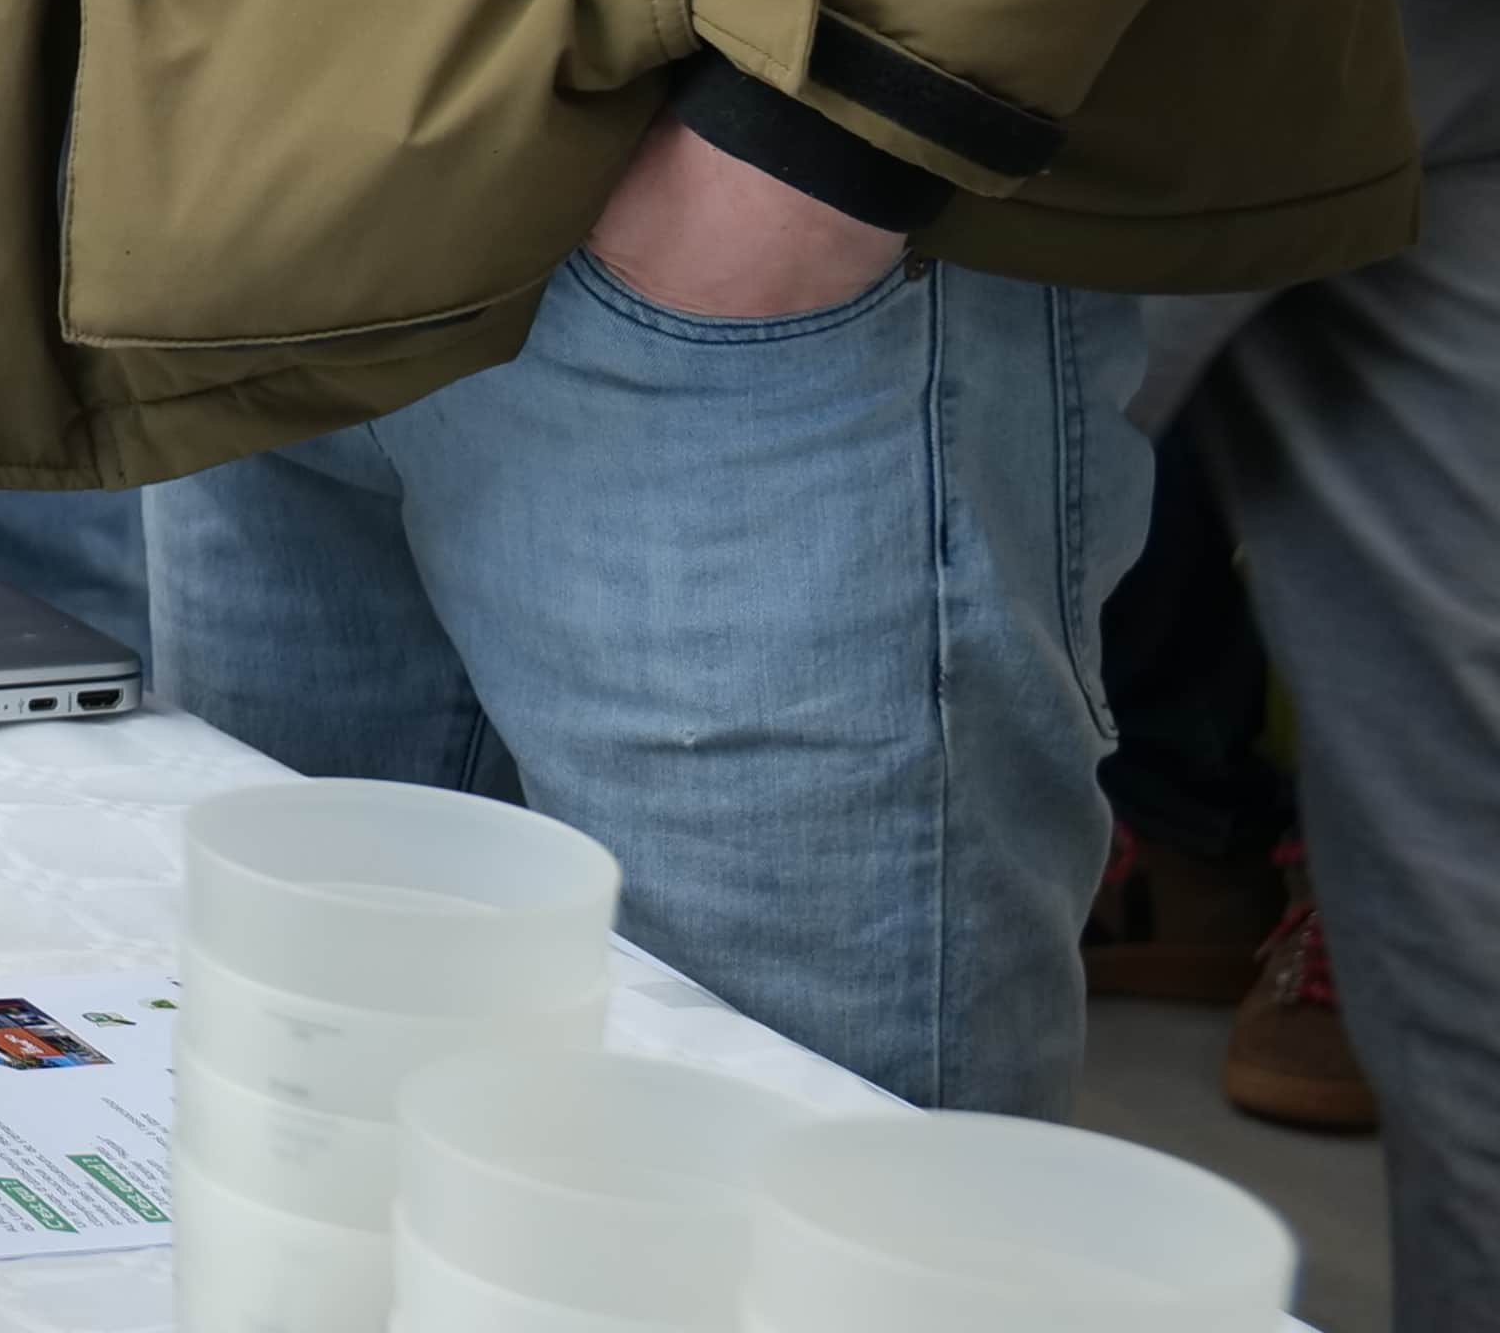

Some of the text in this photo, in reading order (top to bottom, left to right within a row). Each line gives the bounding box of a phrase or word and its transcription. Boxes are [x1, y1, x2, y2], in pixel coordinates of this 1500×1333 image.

[82, 1156, 97, 1164] ?
[94, 1162, 132, 1194] quand
[12, 1186, 37, 1206] qui
[129, 1192, 161, 1219] C'est
[33, 1203, 63, 1229] C'est
